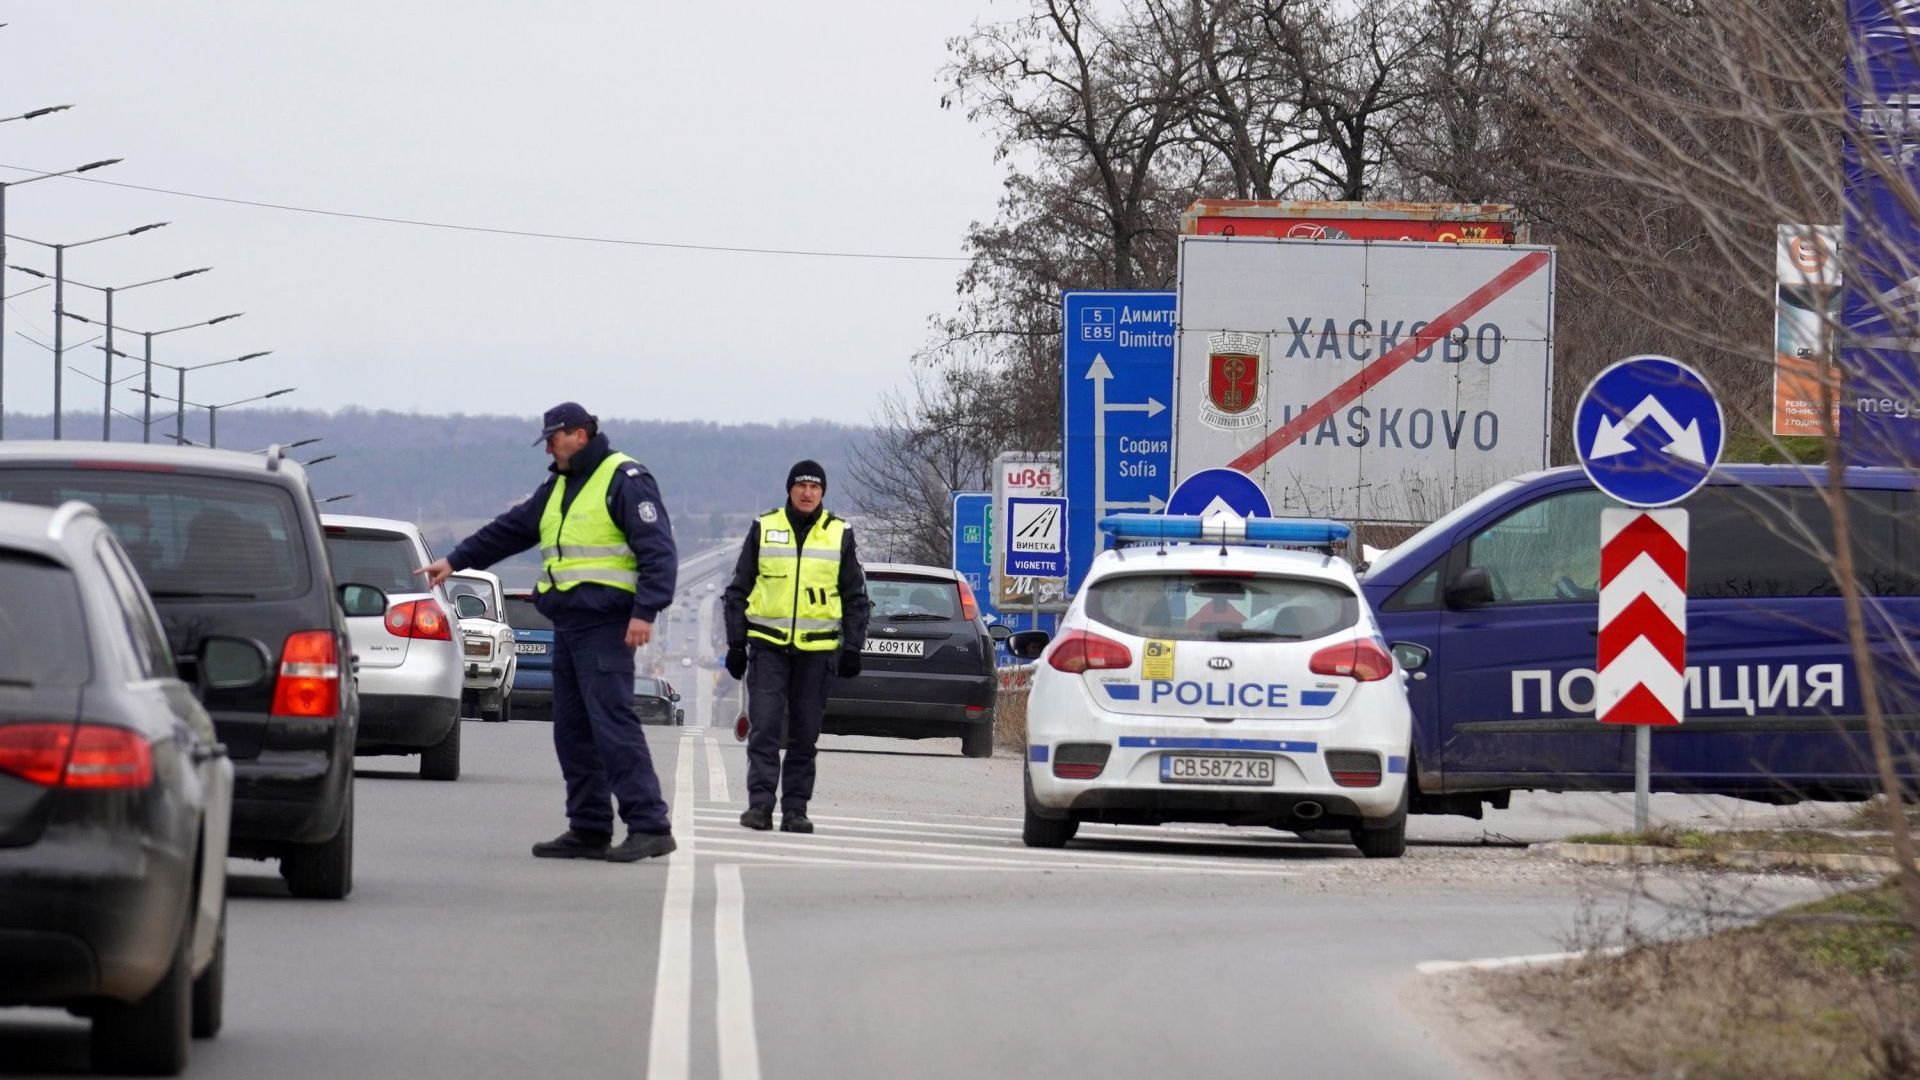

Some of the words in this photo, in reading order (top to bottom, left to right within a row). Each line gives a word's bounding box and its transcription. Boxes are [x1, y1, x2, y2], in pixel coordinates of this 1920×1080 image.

[1094, 310, 1102, 322] 5
[1084, 327, 1112, 339] E85
[1120, 331, 1175, 347] Dimitro
[1285, 317, 1501, 365] ХАСКОВО
[1284, 405, 1499, 451] HASKOVO
[1120, 436, 1168, 455] София
[1120, 460, 1157, 477] Sofia
[1016, 541, 1056, 550] ВИНЕТКА
[1015, 560, 1057, 571] VIGNETTE
[1210, 658, 1231, 668] KIA
[1151, 680, 1288, 708] POLICE
[1512, 664, 1843, 715] ПОИЦИЯ
